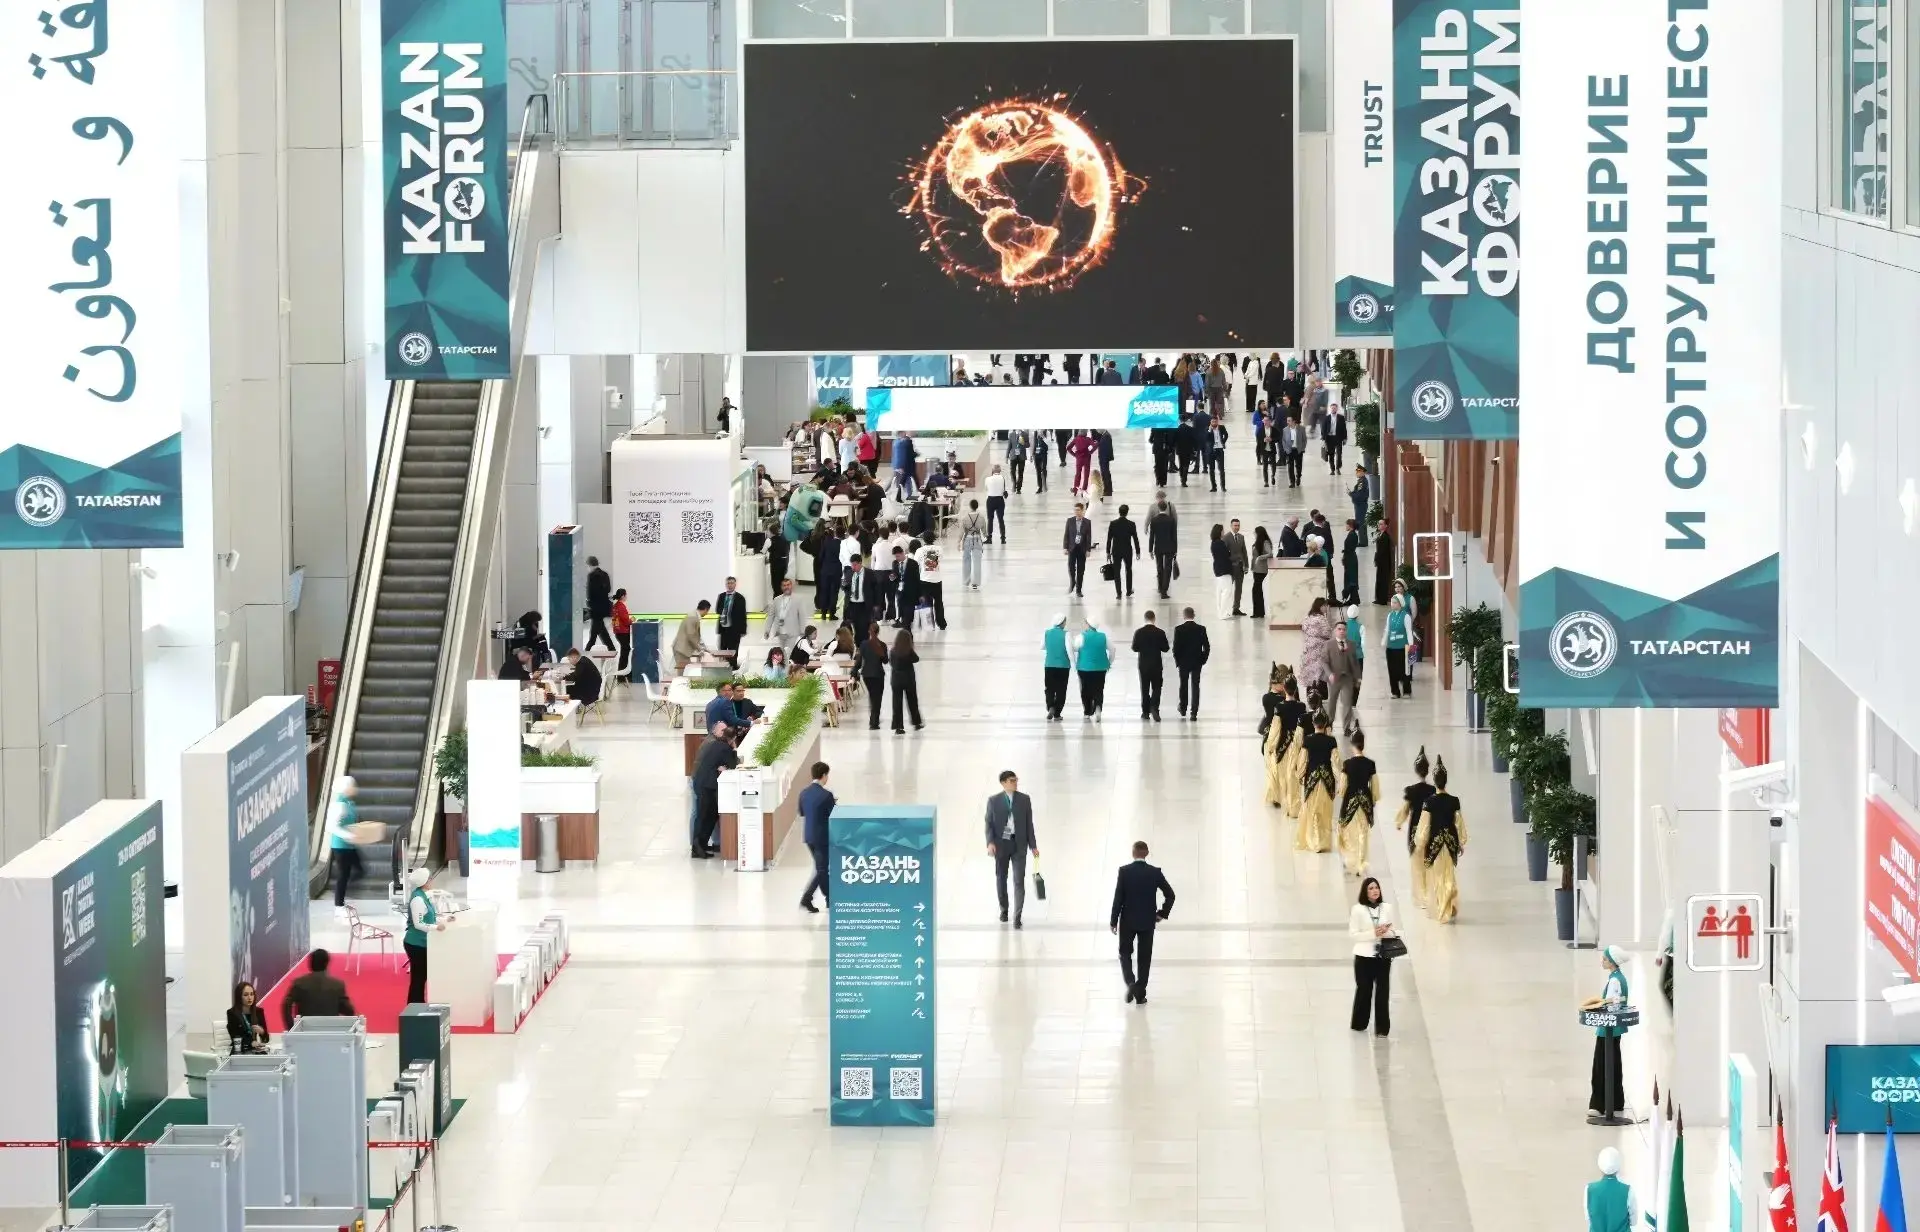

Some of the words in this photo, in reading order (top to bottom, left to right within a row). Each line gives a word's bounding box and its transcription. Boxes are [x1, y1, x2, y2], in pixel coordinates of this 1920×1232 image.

[28, 0, 108, 85] قة
[400, 42, 442, 255] KAZAN
[444, 43, 486, 254] FORUM
[1363, 80, 1385, 168] TRUST
[1420, 8, 1468, 295] КАЗАНЬ
[1471, 9, 1520, 297] ФОРУМ
[1586, 74, 1636, 374] ДОВЕРИЕ
[48, 197, 137, 403] تعاون
[437, 346, 497, 354] ТАТАРСТАН
[75, 495, 161, 507] TATARSTAN
[1665, 511, 1707, 550] И
[1630, 640, 1750, 655] ТАТАРСТАН
[237, 759, 299, 841] КАЗАНЬФОРУМ
[840, 869, 920, 884] ФОРУМ
[841, 855, 920, 869] КАЗАНЬ
[1585, 1012, 1617, 1020] КАЗАНЬ
[1585, 1019, 1617, 1027] ФОРУМ
[1872, 1076, 1920, 1088] КАЗА
